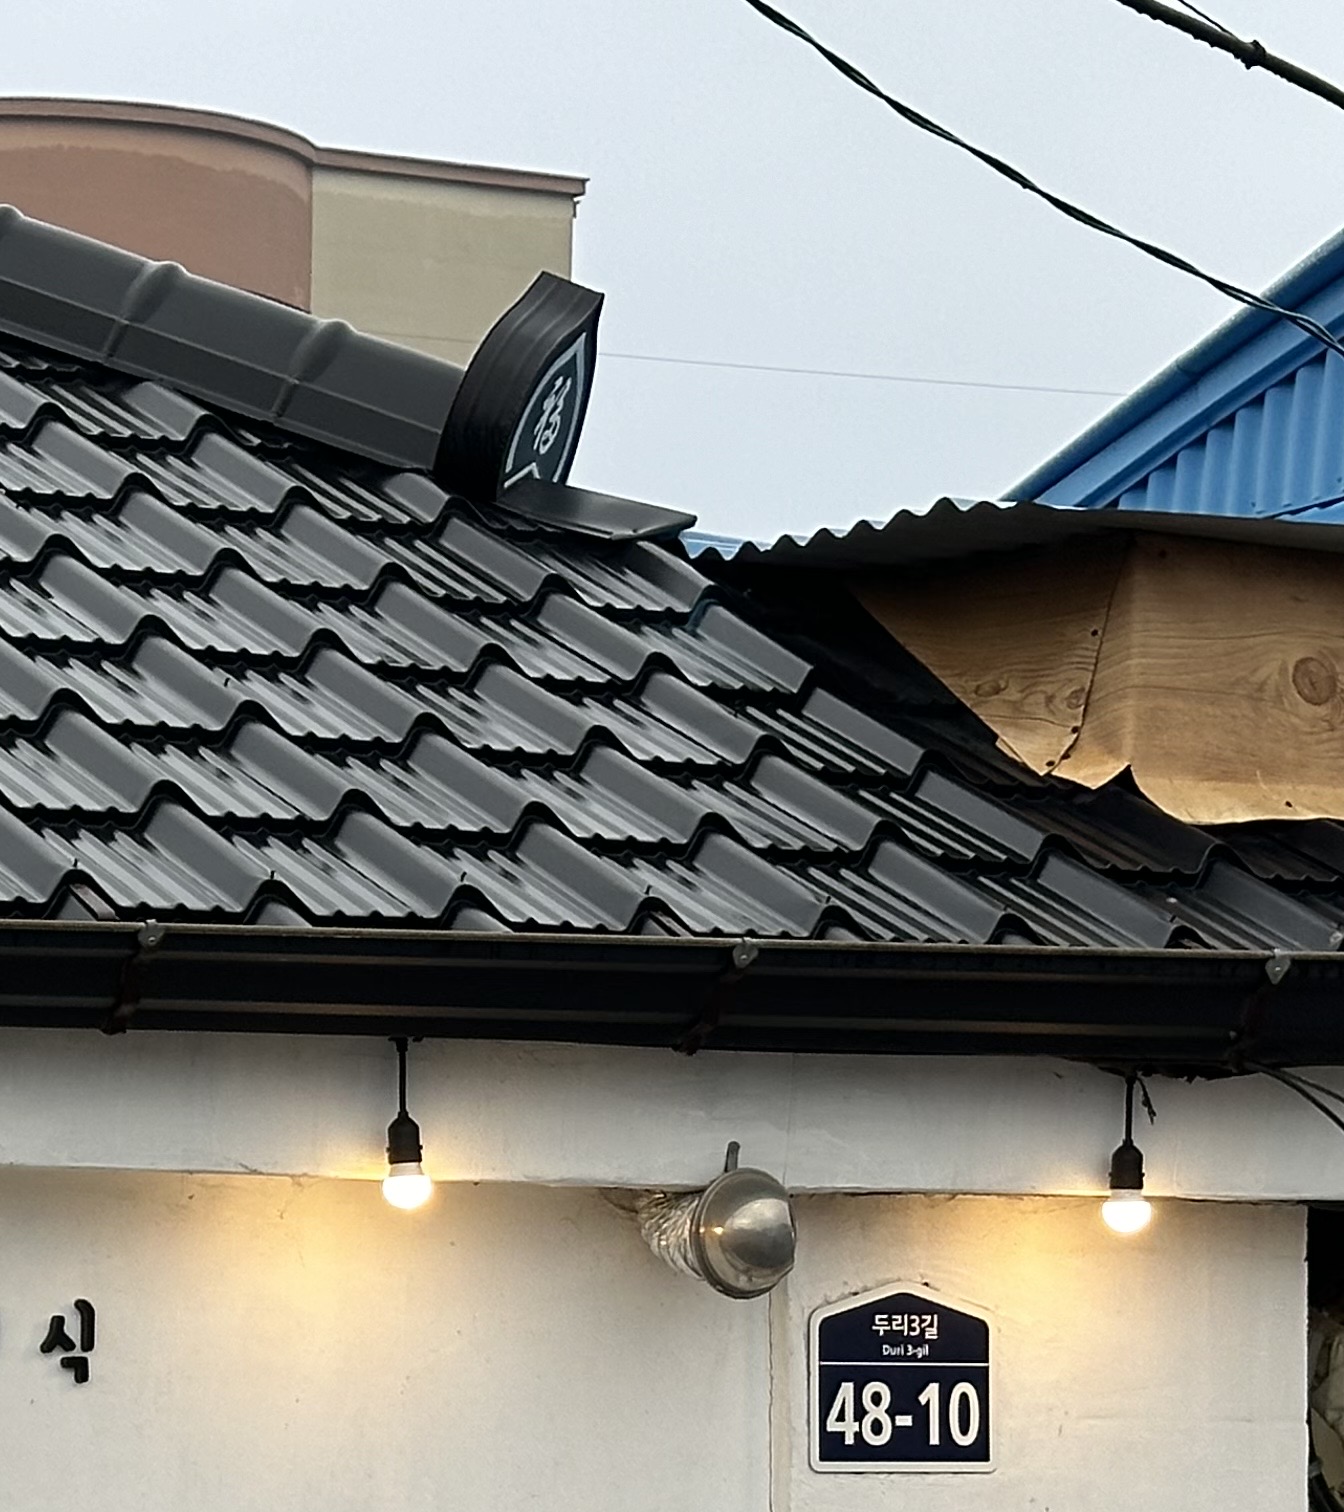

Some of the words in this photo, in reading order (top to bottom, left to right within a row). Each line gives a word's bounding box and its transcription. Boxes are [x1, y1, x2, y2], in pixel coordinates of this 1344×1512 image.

[872, 1313, 939, 1340] 두리3길
[882, 1344, 905, 1356] Duri
[906, 1344, 929, 1359] 3-gil
[826, 1381, 980, 1446] 48-10
